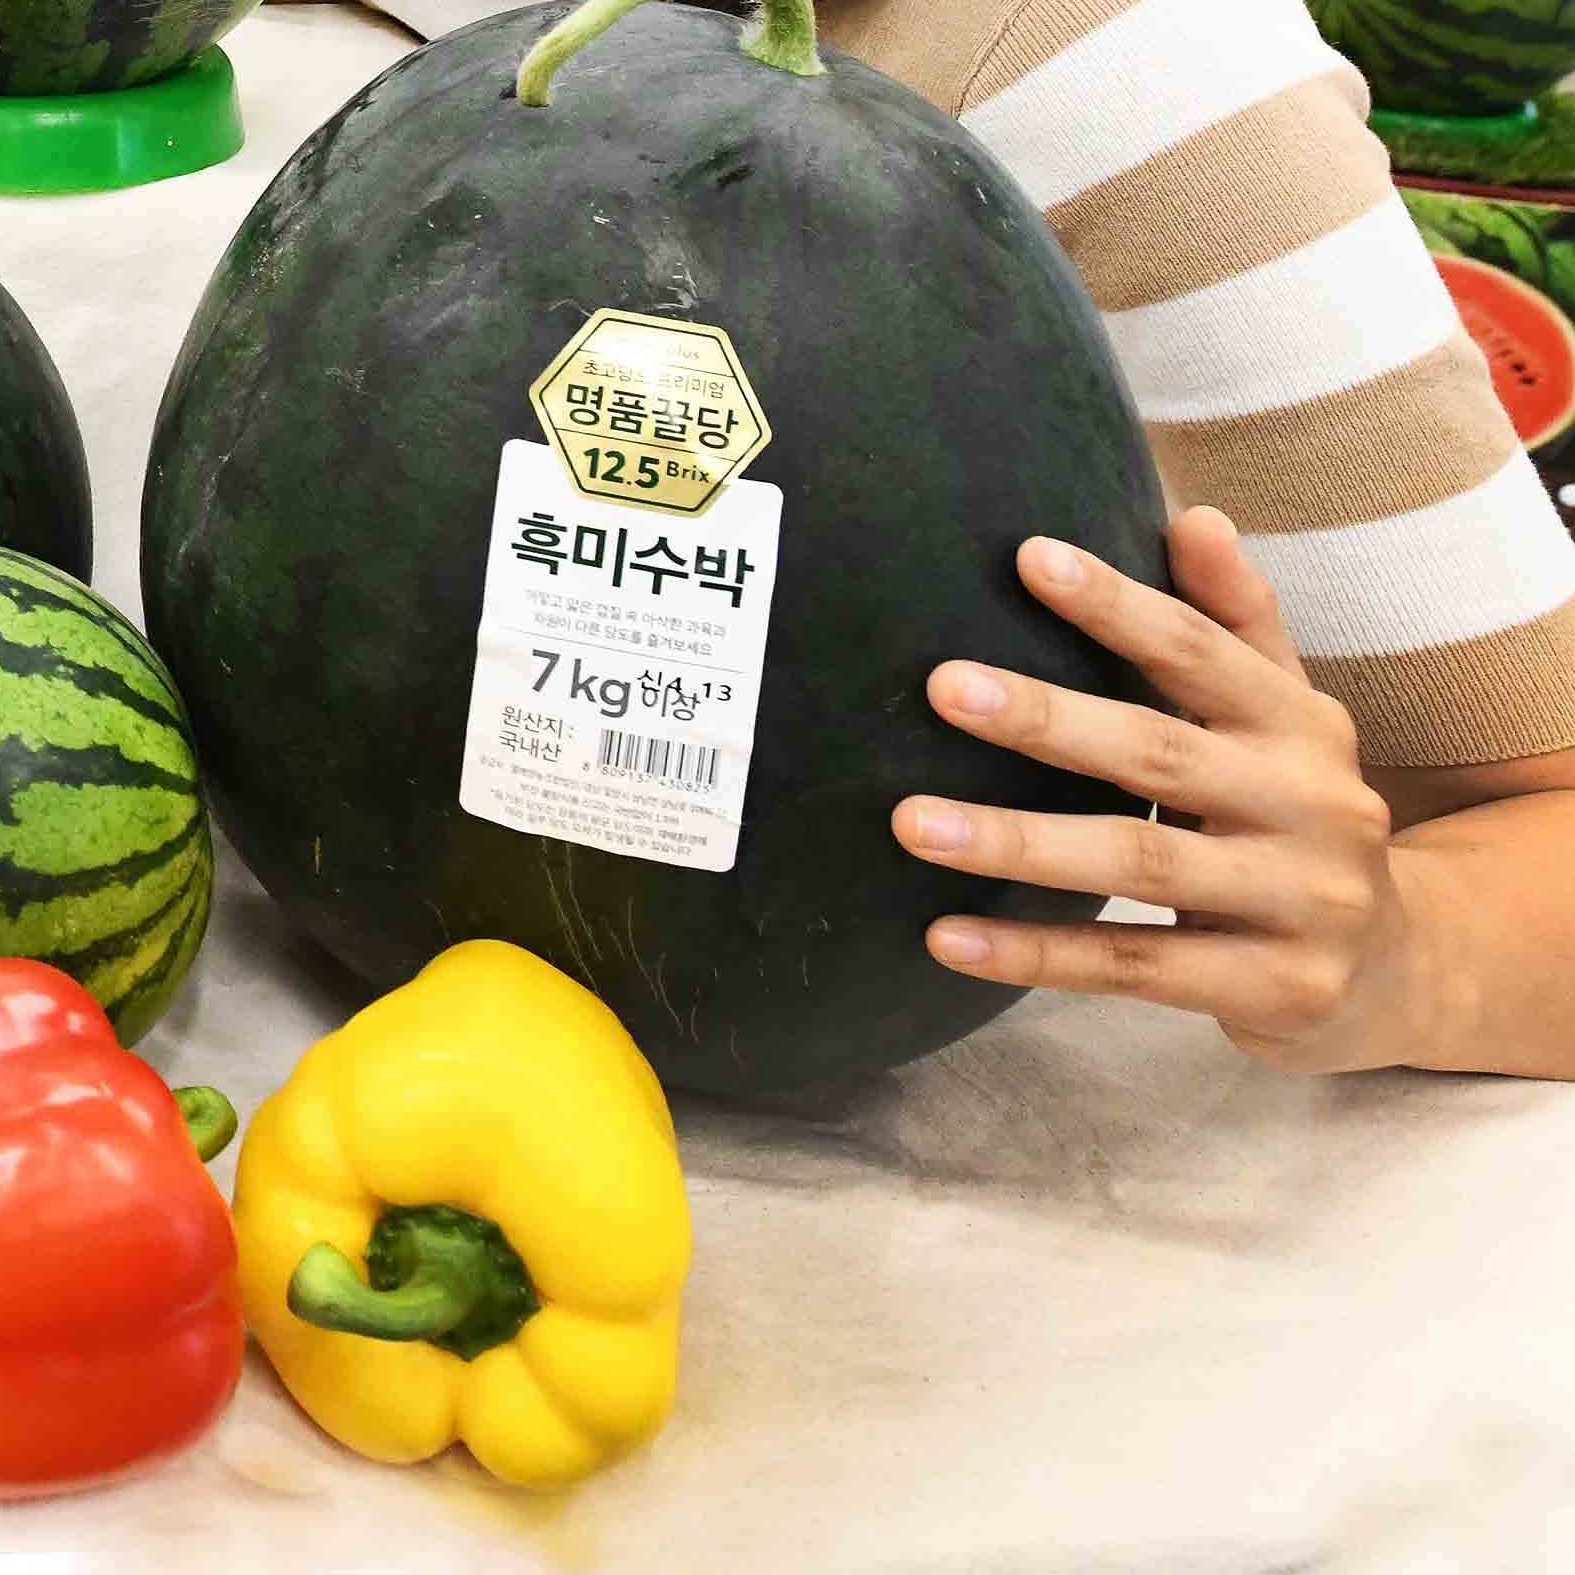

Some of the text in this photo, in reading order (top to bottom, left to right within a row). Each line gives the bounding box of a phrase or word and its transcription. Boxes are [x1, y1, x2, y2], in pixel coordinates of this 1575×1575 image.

[566, 384, 739, 450] 명품꿀당
[584, 447, 710, 489] 12.5 Brix
[510, 512, 756, 608] 흑미수박
[532, 649, 561, 692] 7
[570, 658, 631, 718] kg
[499, 730, 561, 763] 국내산
